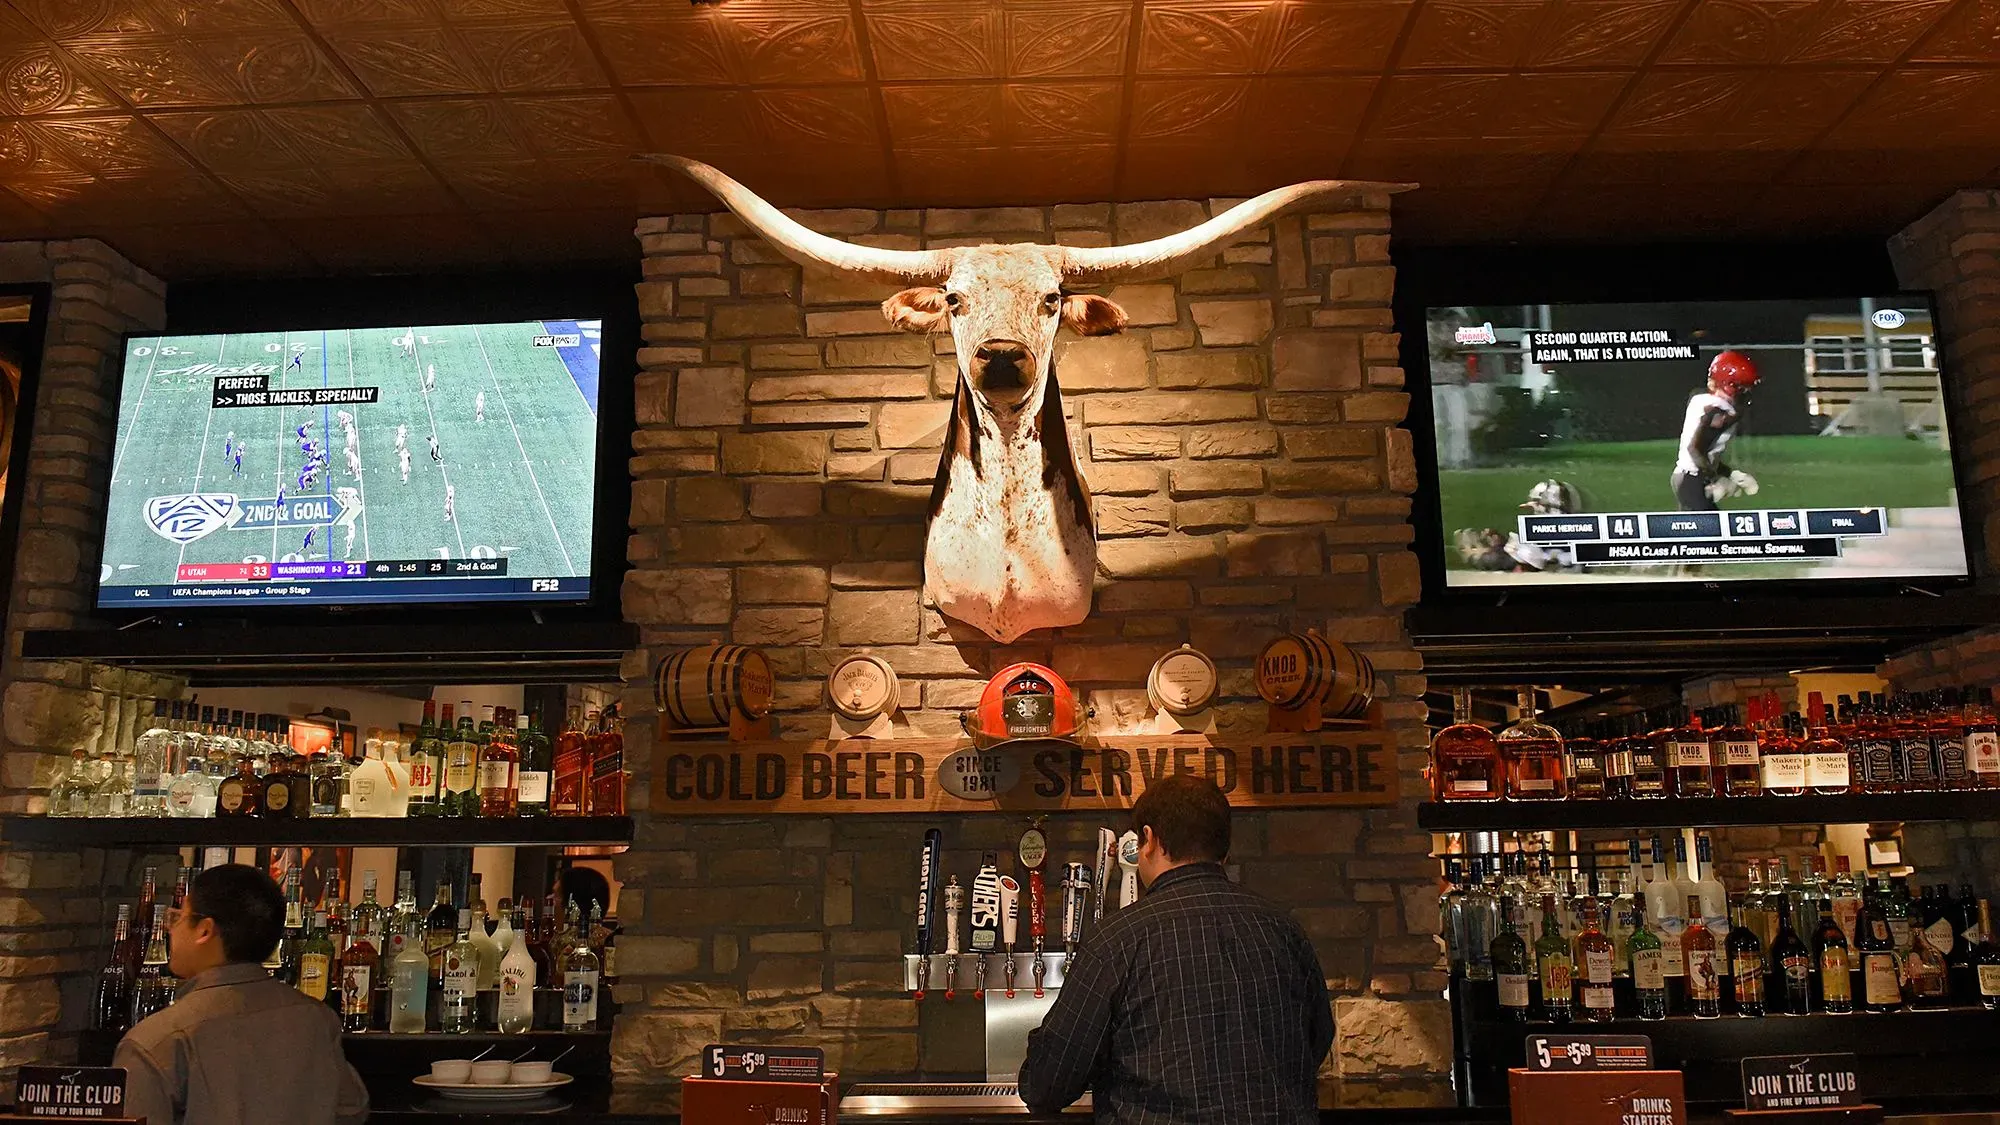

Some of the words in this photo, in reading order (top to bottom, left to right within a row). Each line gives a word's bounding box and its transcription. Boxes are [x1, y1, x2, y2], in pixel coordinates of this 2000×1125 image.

[1878, 313, 1898, 322] FOX
[533, 336, 554, 346] FOX
[1456, 332, 1491, 341] CHAMPS
[1535, 333, 1577, 345] SECOND
[1579, 332, 1628, 344] QUARTER
[1630, 331, 1672, 343] ACTION.
[1536, 349, 1572, 362] AGAIN,
[1574, 349, 1601, 360] THAT
[1603, 348, 1613, 360] IS
[1615, 348, 1624, 359] A
[1624, 347, 1695, 360] TOUCHDOWN.
[218, 377, 264, 389] PERFECT.
[236, 393, 268, 406] THOSE
[269, 391, 314, 404] TACKLES,
[315, 388, 374, 402] ESPECIALLY
[244, 505, 273, 523] 2ND
[293, 502, 332, 520] GOAL
[171, 518, 206, 533] 12
[1532, 525, 1557, 533] PARKE
[1557, 524, 1594, 532] HERITAGE
[1614, 519, 1634, 536] 44
[1671, 522, 1698, 531] ATTICA
[1735, 516, 1755, 533] 26
[1832, 518, 1855, 527] FINAL
[1609, 546, 1640, 557] IHSAA
[1670, 545, 1679, 556] A
[187, 568, 207, 576] UTAH
[252, 566, 268, 577] 33
[277, 565, 325, 574] WASHINGTON
[346, 564, 362, 575] 21
[376, 563, 390, 573] 4th
[398, 563, 417, 572] 1:45
[430, 563, 442, 572] 25
[456, 562, 471, 571] 2nd
[472, 562, 479, 570] &
[480, 561, 497, 571] Goal
[532, 578, 559, 592] FS2
[135, 589, 150, 597] UCL
[173, 588, 191, 596] UEFA
[192, 588, 233, 598] Champions
[233, 587, 260, 597] League
[265, 587, 288, 597] Group
[289, 586, 311, 597] Stage
[1263, 654, 1297, 677] KNOB
[1020, 681, 1038, 690] CFC
[1266, 674, 1301, 685] CREEK
[1010, 725, 1048, 734] FIREFIGHTER
[1680, 745, 1700, 755] KNOB
[1728, 744, 1749, 754] KNOB
[956, 756, 1002, 773] SINCE
[1576, 757, 1594, 766] KNOB
[1634, 755, 1651, 763] KNOB
[665, 752, 786, 801] COLD
[802, 750, 925, 800] BEER
[1032, 746, 1238, 798] SERVED
[1251, 743, 1386, 794] HERE
[963, 775, 996, 792] 1981
[920, 846, 931, 890] LIGHT
[917, 892, 927, 926] BUD
[1031, 886, 1040, 925] LAGER
[1536, 1039, 1551, 1068] 5
[713, 1048, 725, 1077] 5
[1749, 1075, 1782, 1095] JOIN
[1786, 1073, 1814, 1093] THE
[1818, 1072, 1857, 1092] CLUB
[19, 1084, 50, 1102] JOIN
[56, 1085, 81, 1103] THE
[86, 1086, 122, 1104] CLUB
[1632, 1098, 1672, 1113] DRINKS
[1767, 1098, 1779, 1107] AND
[1780, 1098, 1793, 1106] FIRE
[1795, 1097, 1803, 1106] UP
[1804, 1096, 1820, 1105] YOUR
[1821, 1096, 1840, 1104] INBOX
[33, 1106, 44, 1114] AND
[45, 1106, 58, 1115] FIRE
[60, 1107, 67, 1115] UP
[69, 1107, 83, 1115] YOUR
[85, 1108, 103, 1116] INBOX
[775, 1107, 808, 1122] DRINKS
[1622, 1114, 1673, 1125] STARTERS
